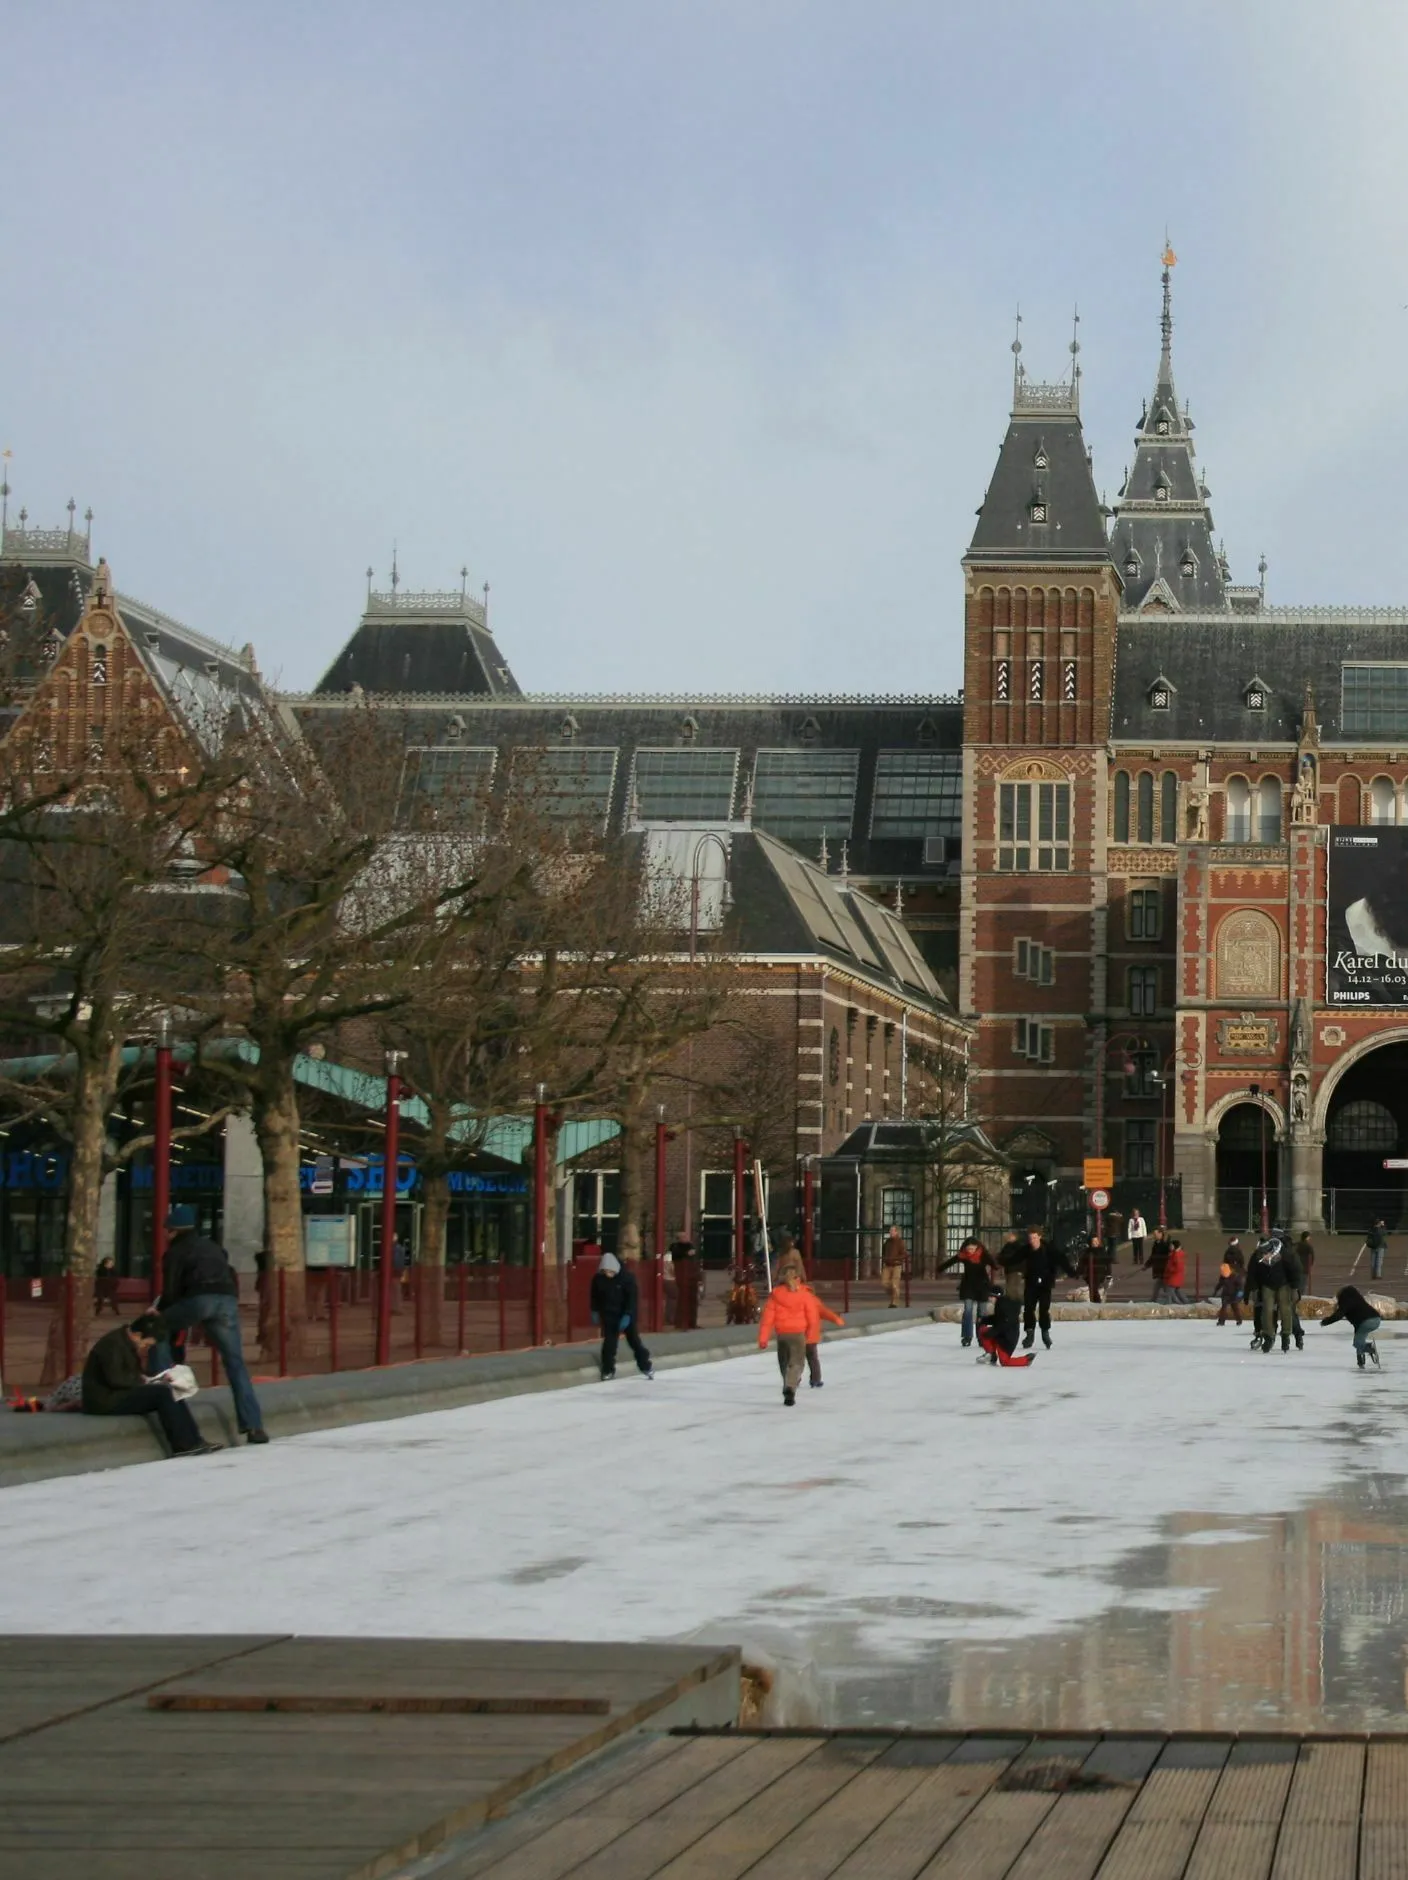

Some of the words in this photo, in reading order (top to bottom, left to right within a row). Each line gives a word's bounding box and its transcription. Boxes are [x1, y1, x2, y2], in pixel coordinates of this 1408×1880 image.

[1333, 951, 1378, 974] Karel
[1385, 951, 1408, 969] du
[1333, 991, 1370, 1000] PHILIPS
